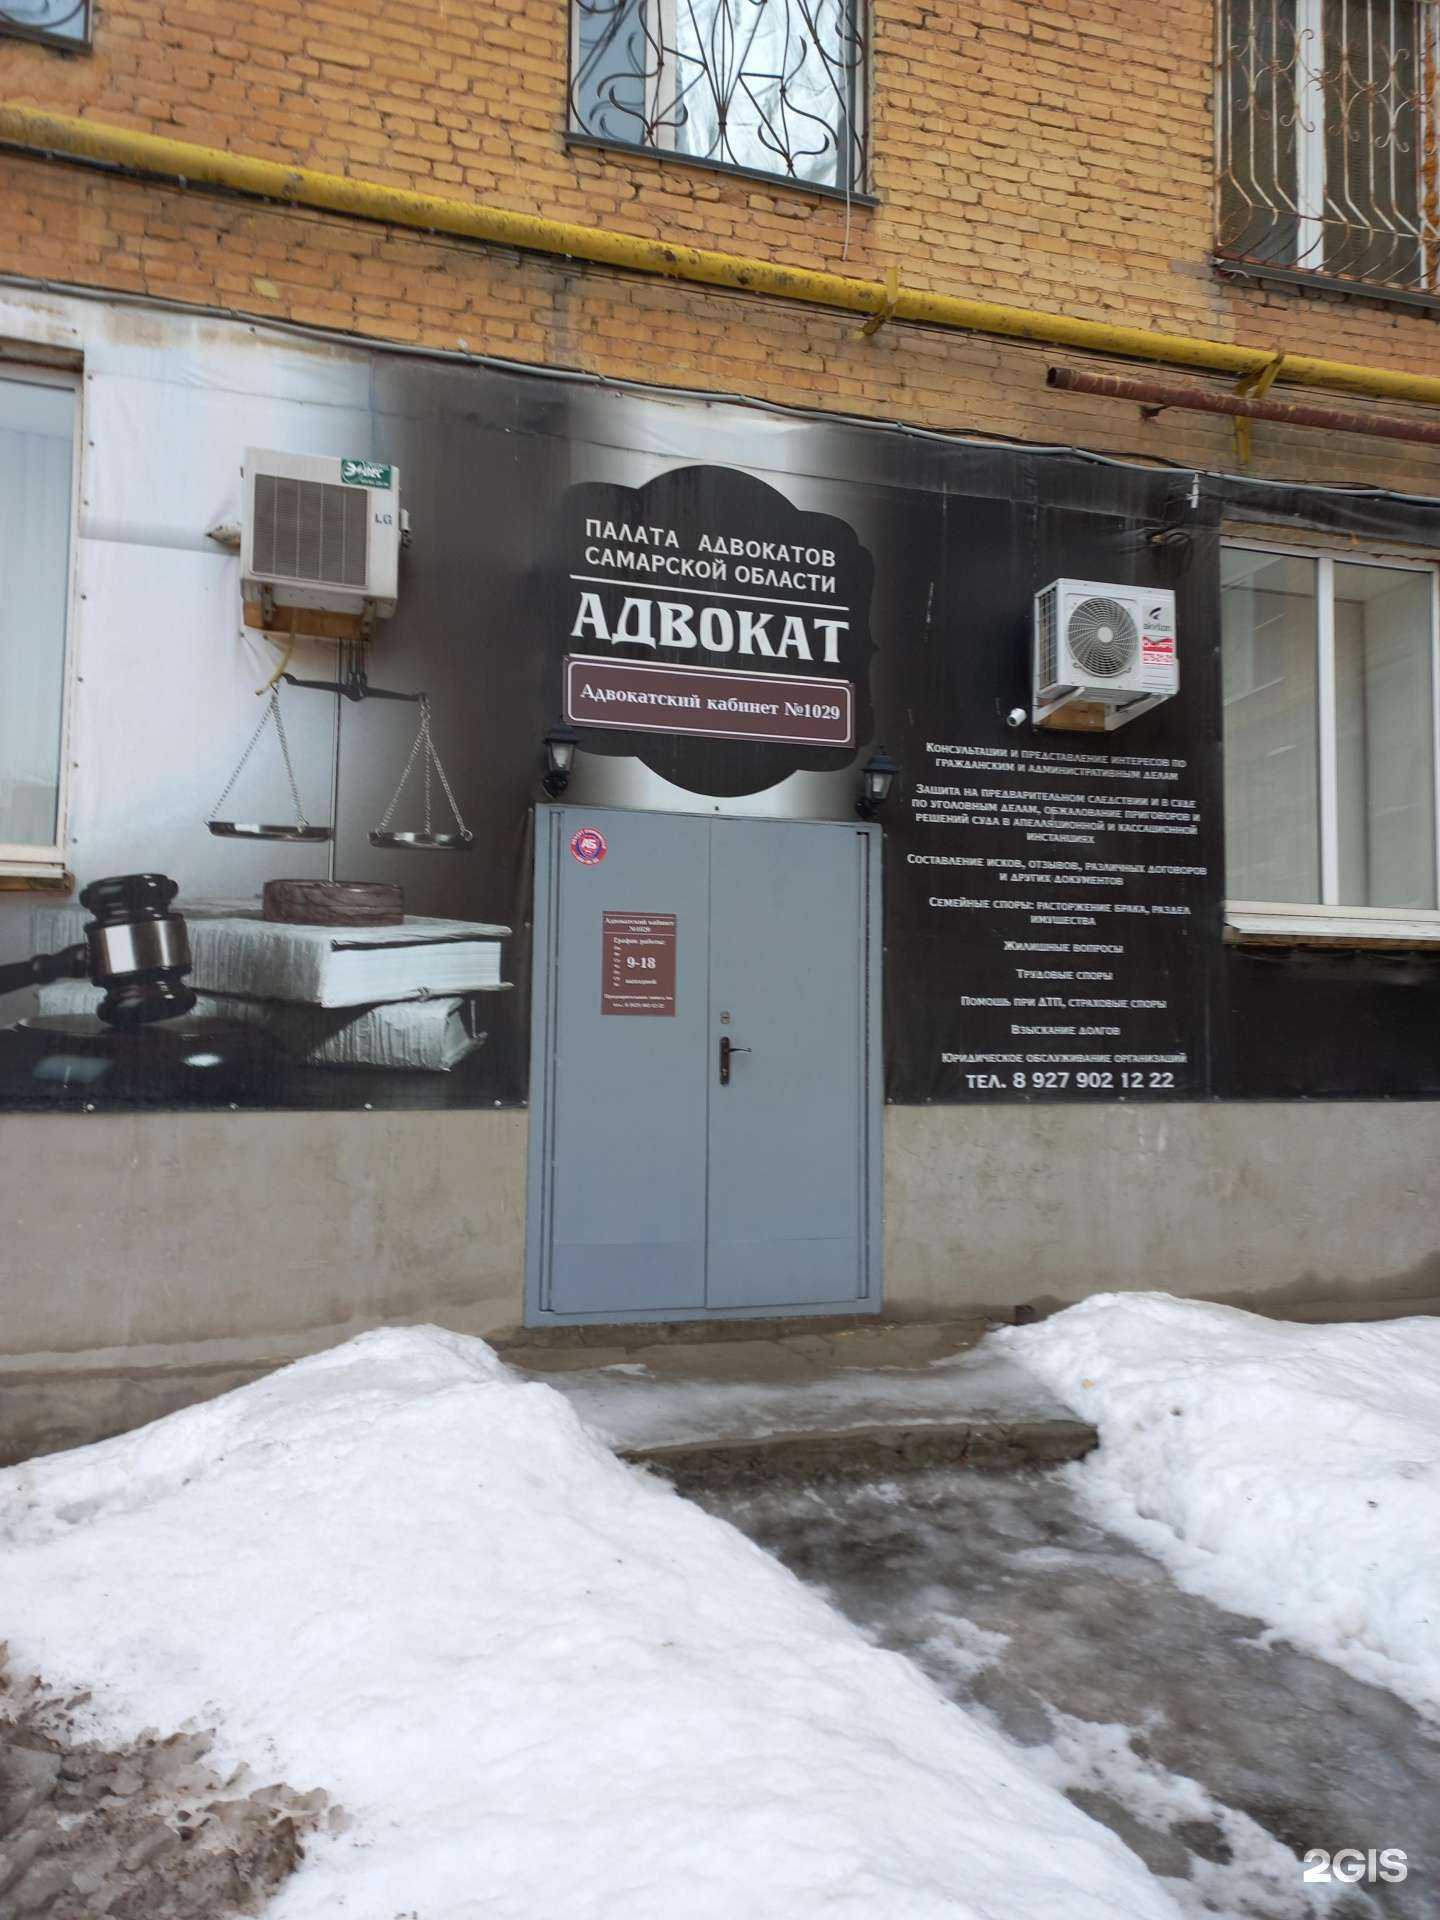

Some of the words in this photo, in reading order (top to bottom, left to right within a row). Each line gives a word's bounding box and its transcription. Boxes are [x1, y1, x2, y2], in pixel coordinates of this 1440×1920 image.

[375, 512, 392, 525] LG
[585, 518, 680, 548] ПАЛАТА
[698, 534, 836, 567] АДВОКАТОВ
[584, 546, 727, 581] САМАРСКОЙ
[734, 565, 836, 593] ОБЛАСТИ
[570, 591, 850, 663] АДВОКАТ
[580, 683, 701, 708] Адвокатский
[707, 697, 780, 716] кабинет
[784, 701, 841, 720] №1029
[1010, 749, 1019, 758] И
[1021, 750, 1109, 764] ПРЕДСТАВЛЕНИЕ
[1110, 756, 1170, 767] ИНТЕРЕСОВ
[1171, 759, 1187, 768] ПО
[935, 758, 1015, 772] ГРАЖДАНСКИМ
[1017, 764, 1026, 772] И
[1028, 765, 1141, 779] АДМИНИСТРАТИВНЫМ
[1143, 771, 1179, 780] ДЕЛАМ
[963, 788, 979, 797] НА
[981, 788, 1086, 803] ПРЕДВАРИТЕЛЬНОМ
[1087, 795, 1149, 805] СЛЕДСТВИИ
[1151, 798, 1159, 806] И
[1161, 798, 1169, 807] В
[1170, 799, 1196, 808] СУДЕ
[912, 799, 928, 808] ПО
[930, 800, 998, 812] УГОЛОВНЫМ
[1044, 806, 1123, 818] ОБЖАЛОВАНИЕ
[1124, 811, 1191, 821] ПРИГОВОРОВ
[1192, 814, 1200, 822] И
[915, 813, 970, 824] РЕШЕНИЙ
[971, 816, 1000, 826] СУДА
[1002, 818, 1011, 826] В
[1107, 823, 1116, 831] И
[1118, 823, 1198, 835] КАССАЦИОННОЙ
[1085, 862, 1145, 873] РАЗЛИЧНЫХ
[1147, 864, 1207, 875] ДОГОВОРОВ
[1000, 873, 1008, 881] И
[1010, 873, 1052, 883] ДРУГИХ
[1054, 874, 1124, 886] ДОКУМЕНТОВ
[1036, 901, 1113, 913] РАСТОРЖЕНИЕ
[1151, 905, 1191, 915] РАЗДЕЛ
[1030, 915, 1097, 926] ИМУЩЕСТВА
[1072, 943, 1124, 954] ВОПРОСЫ
[626, 956, 657, 969] 9-18
[1076, 970, 1113, 981] СПОРЫ
[1013, 997, 1036, 1007] ПРИ
[1068, 998, 1129, 1009] СТРАХОВЫЕ
[1130, 999, 1168, 1009] СПОРЫ
[1078, 1025, 1121, 1036] ДОЛГОВ
[1026, 1053, 1113, 1063] ОБСЛУЖИВАНИЕ
[966, 1073, 1007, 1089] ТЕЛ.
[1012, 1072, 1026, 1088] 8
[1032, 1072, 1070, 1088] 927
[1075, 1072, 1114, 1088] 902
[1121, 1072, 1144, 1088] 12
[1149, 1072, 1175, 1088] 22
